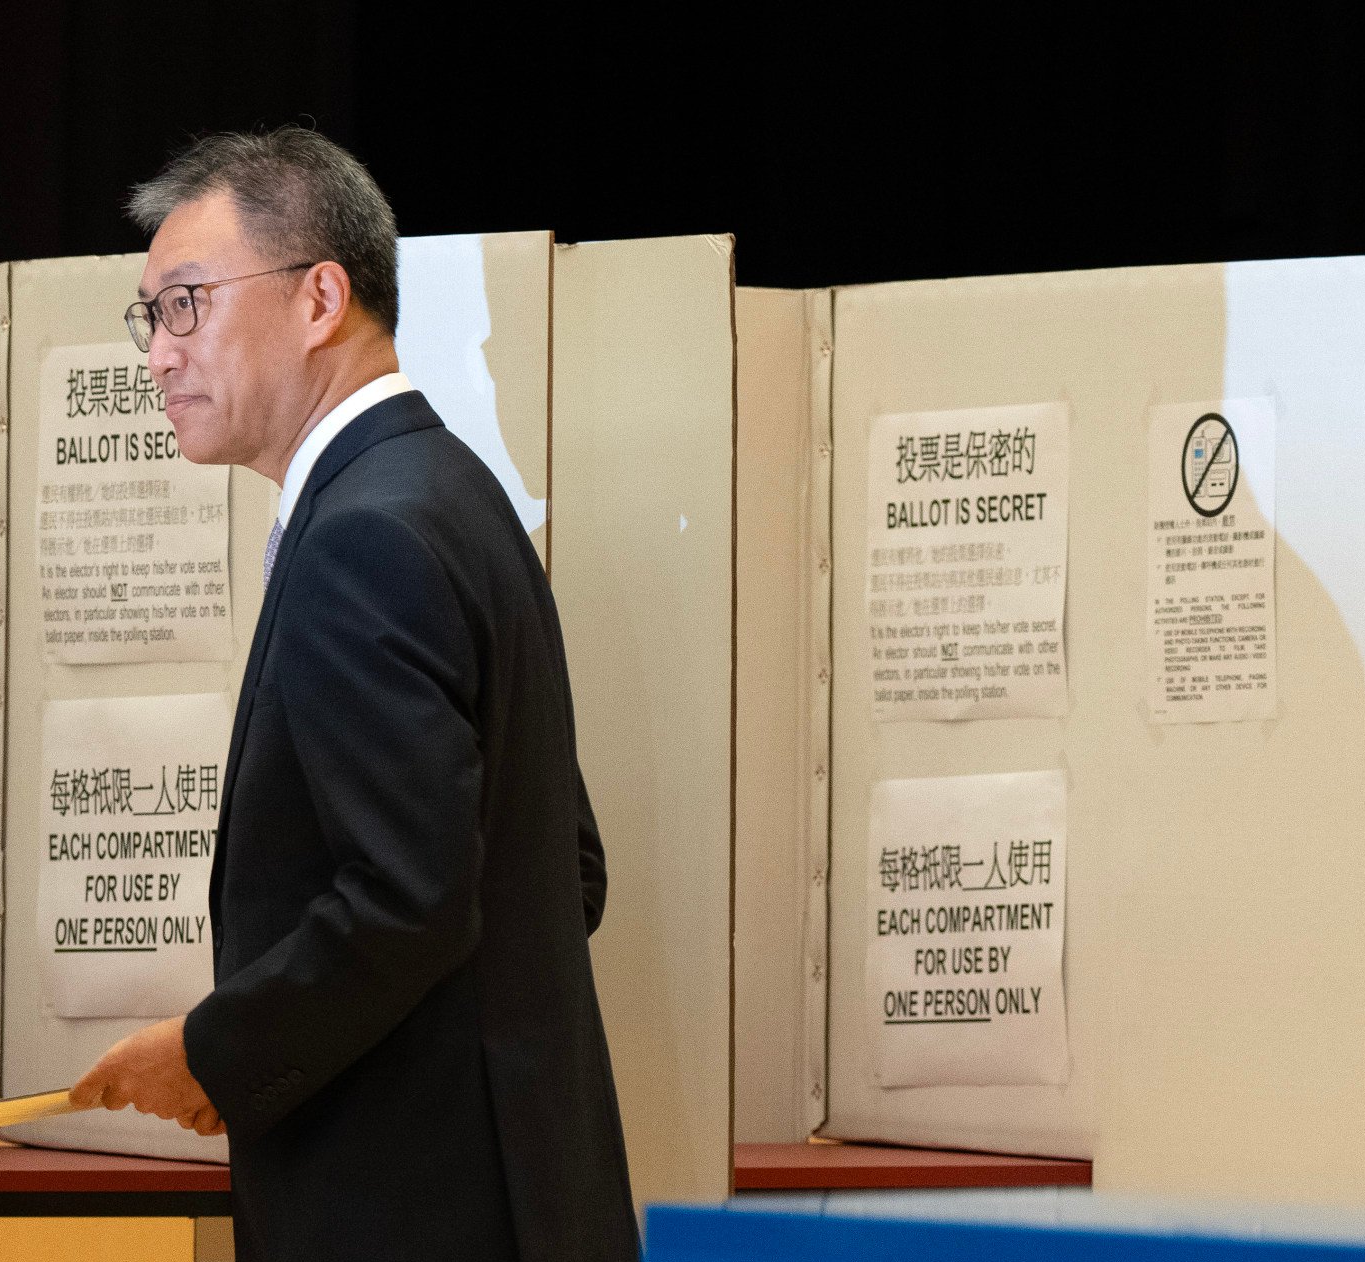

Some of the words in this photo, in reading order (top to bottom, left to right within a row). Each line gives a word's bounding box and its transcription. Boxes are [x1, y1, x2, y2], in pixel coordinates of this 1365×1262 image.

[56, 434, 120, 465] BALLOT
[125, 433, 139, 461] IS
[144, 431, 181, 460] SEC
[896, 426, 1036, 484] 投票是保密的
[887, 498, 951, 529] BALLOT
[956, 497, 970, 525] IS
[976, 493, 1047, 524] SECRET
[110, 582, 128, 598] NOT
[941, 642, 959, 657] NOT
[49, 833, 91, 861] EACH
[86, 875, 117, 902] FOR
[123, 874, 154, 901] USE
[158, 873, 181, 900] BY
[55, 917, 88, 945] ONE
[93, 916, 158, 945] PERSON
[163, 916, 206, 944] ONLY
[877, 908, 921, 936] EACH
[926, 903, 1053, 934] COMPARTMENT
[915, 948, 946, 975] FOR
[952, 947, 983, 974] USE
[989, 946, 1011, 973] BY
[885, 990, 918, 1017] ONE
[924, 988, 990, 1017] PERSON
[995, 987, 1042, 1014] ONLY
